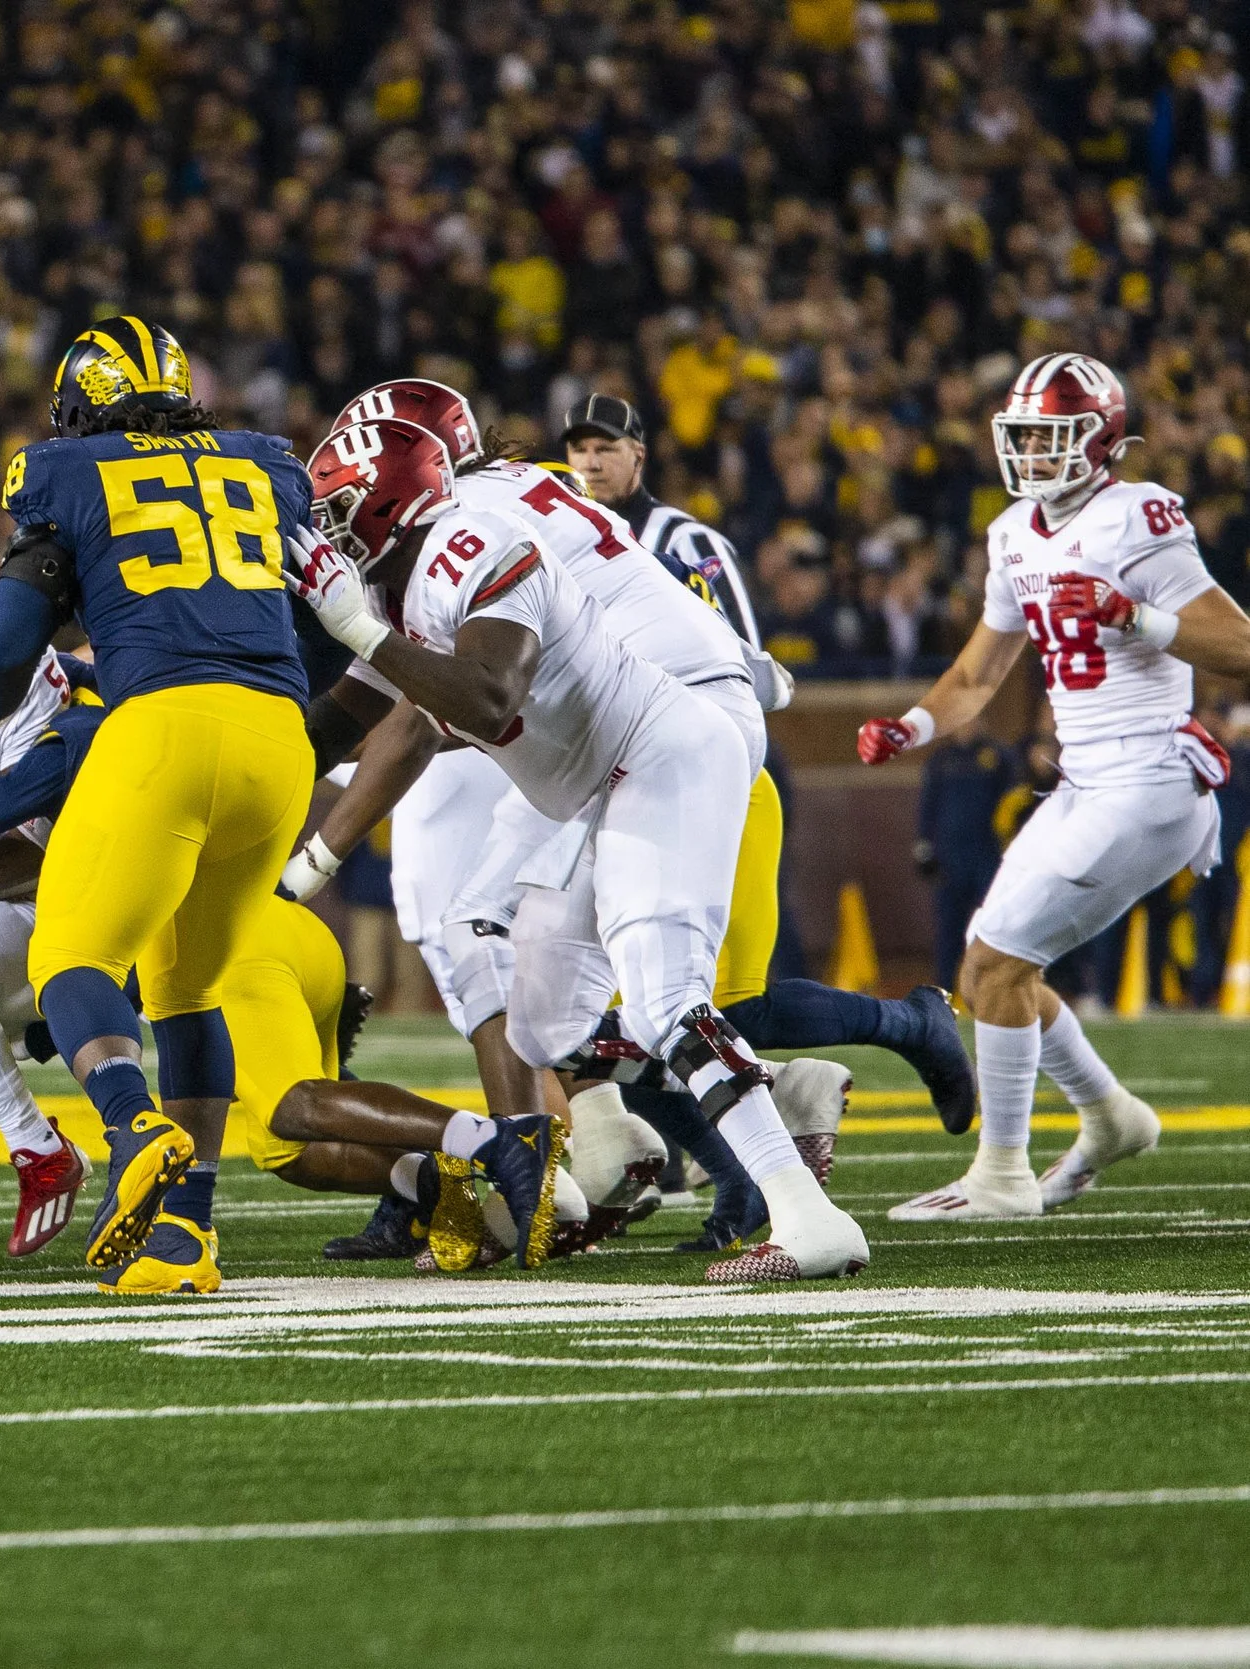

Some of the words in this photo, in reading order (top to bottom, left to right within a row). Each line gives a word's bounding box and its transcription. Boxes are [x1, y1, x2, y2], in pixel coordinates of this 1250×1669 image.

[124, 431, 221, 452] SMITH
[1, 452, 26, 510] 8
[96, 454, 286, 595] 58
[427, 529, 485, 588] 76
